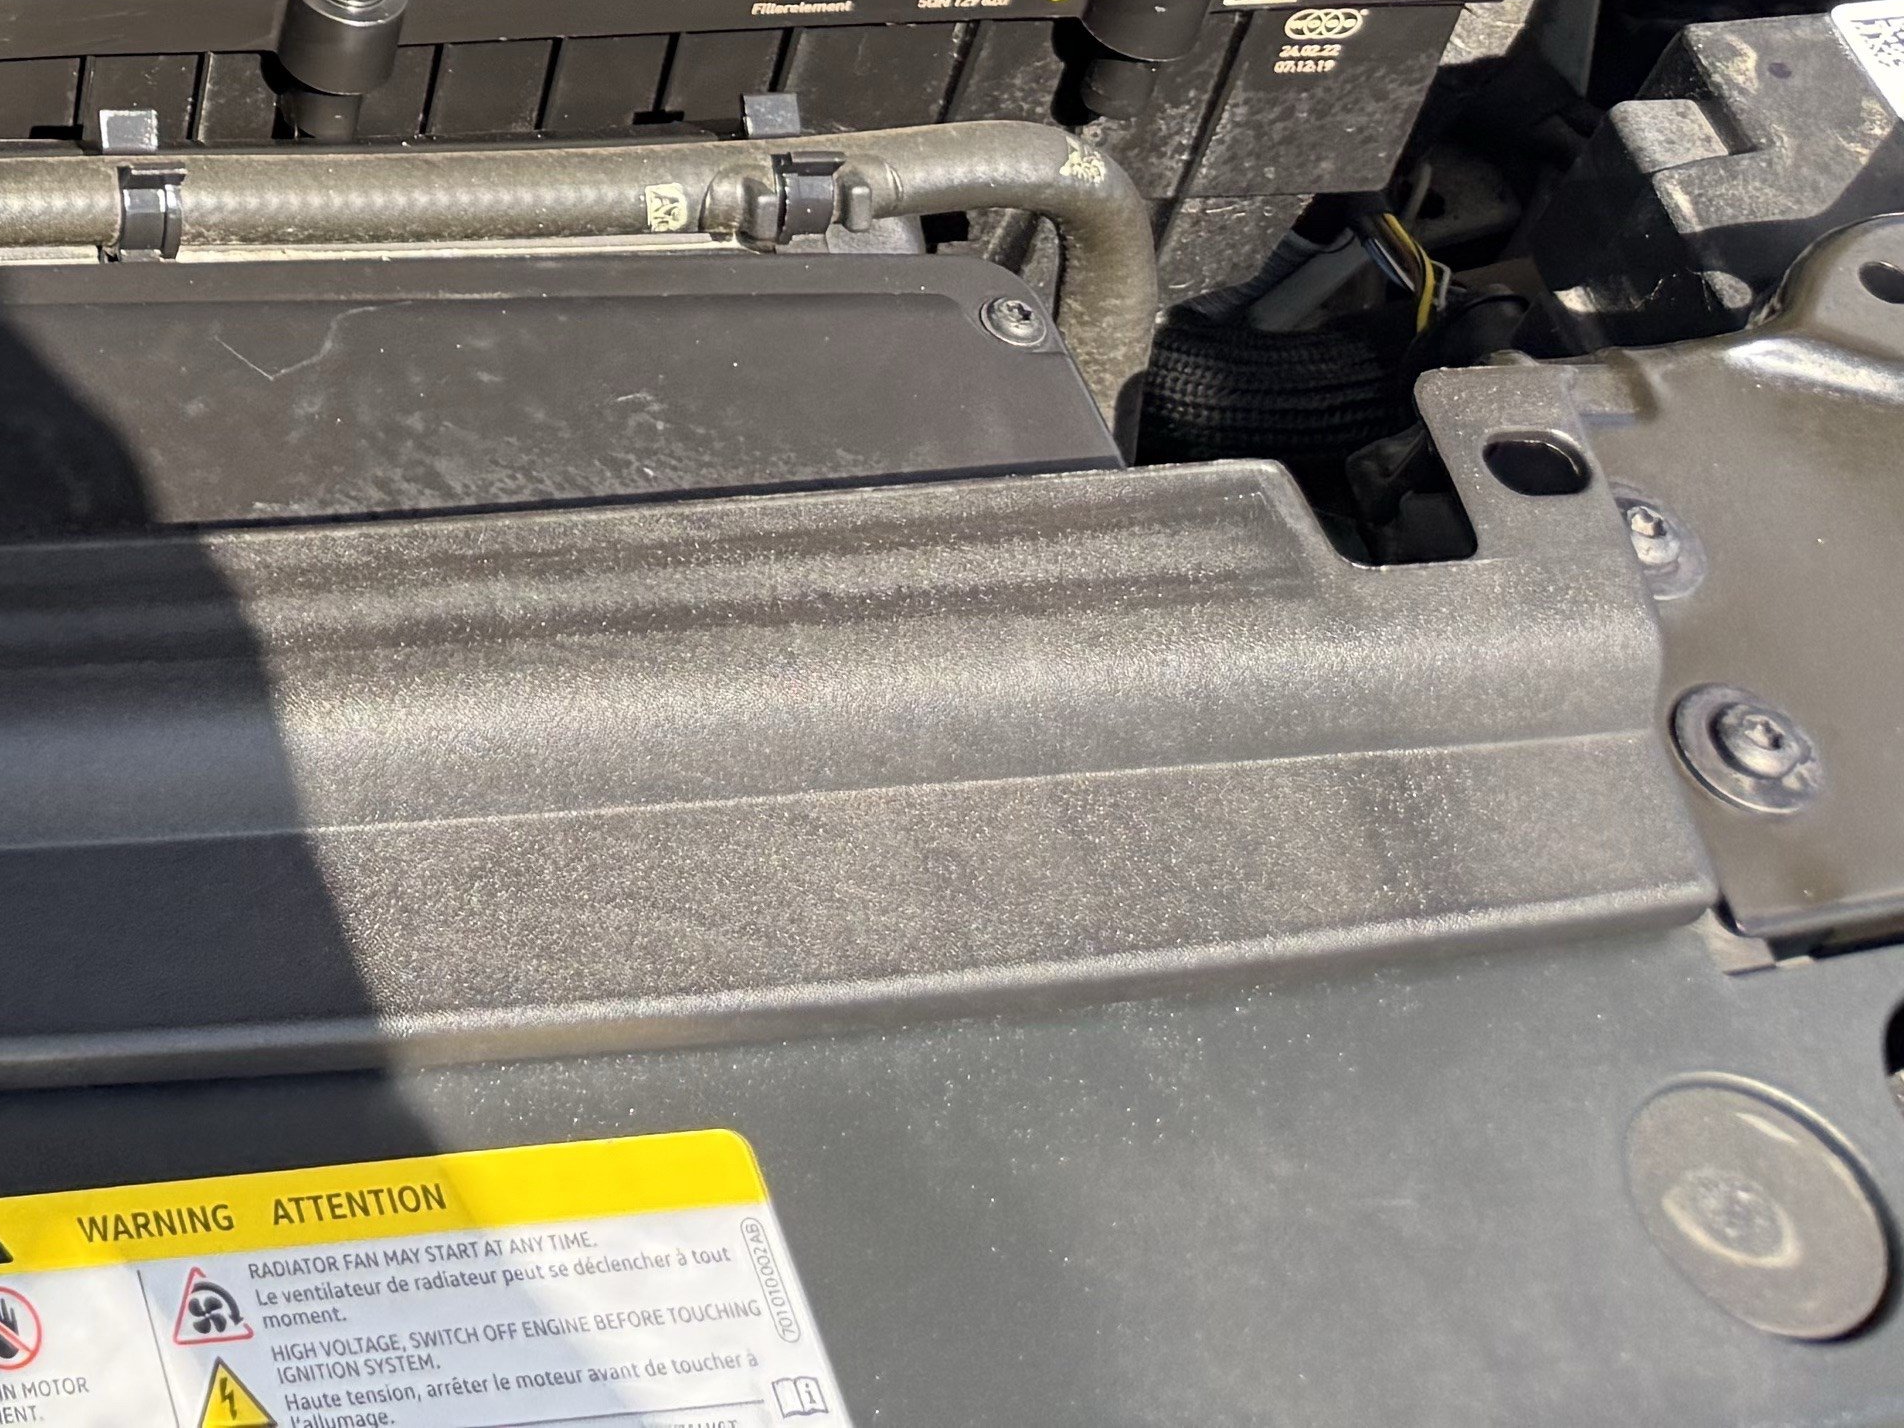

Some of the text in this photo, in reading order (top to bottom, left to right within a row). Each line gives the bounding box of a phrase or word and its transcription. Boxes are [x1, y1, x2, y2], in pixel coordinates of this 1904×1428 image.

[77, 1182, 448, 1244] WARNING ATTENTION
[248, 1230, 598, 1280] RADIATOR FAN MAY START AT ANY TIME.
[255, 1245, 732, 1308] Le ventilateur de radiateur peut se déclencher à tout
[261, 1306, 347, 1330] moment.
[271, 1299, 763, 1363] HIGH VOLTAGE, SWITCH OFF ENGINE BEFORE TOUCHING
[21, 1377, 90, 1398] MOTOR
[276, 1353, 441, 1385] IGNITION SYSTEM.
[285, 1349, 760, 1411] Haute tension, arrêter le moteur avant de toucher à
